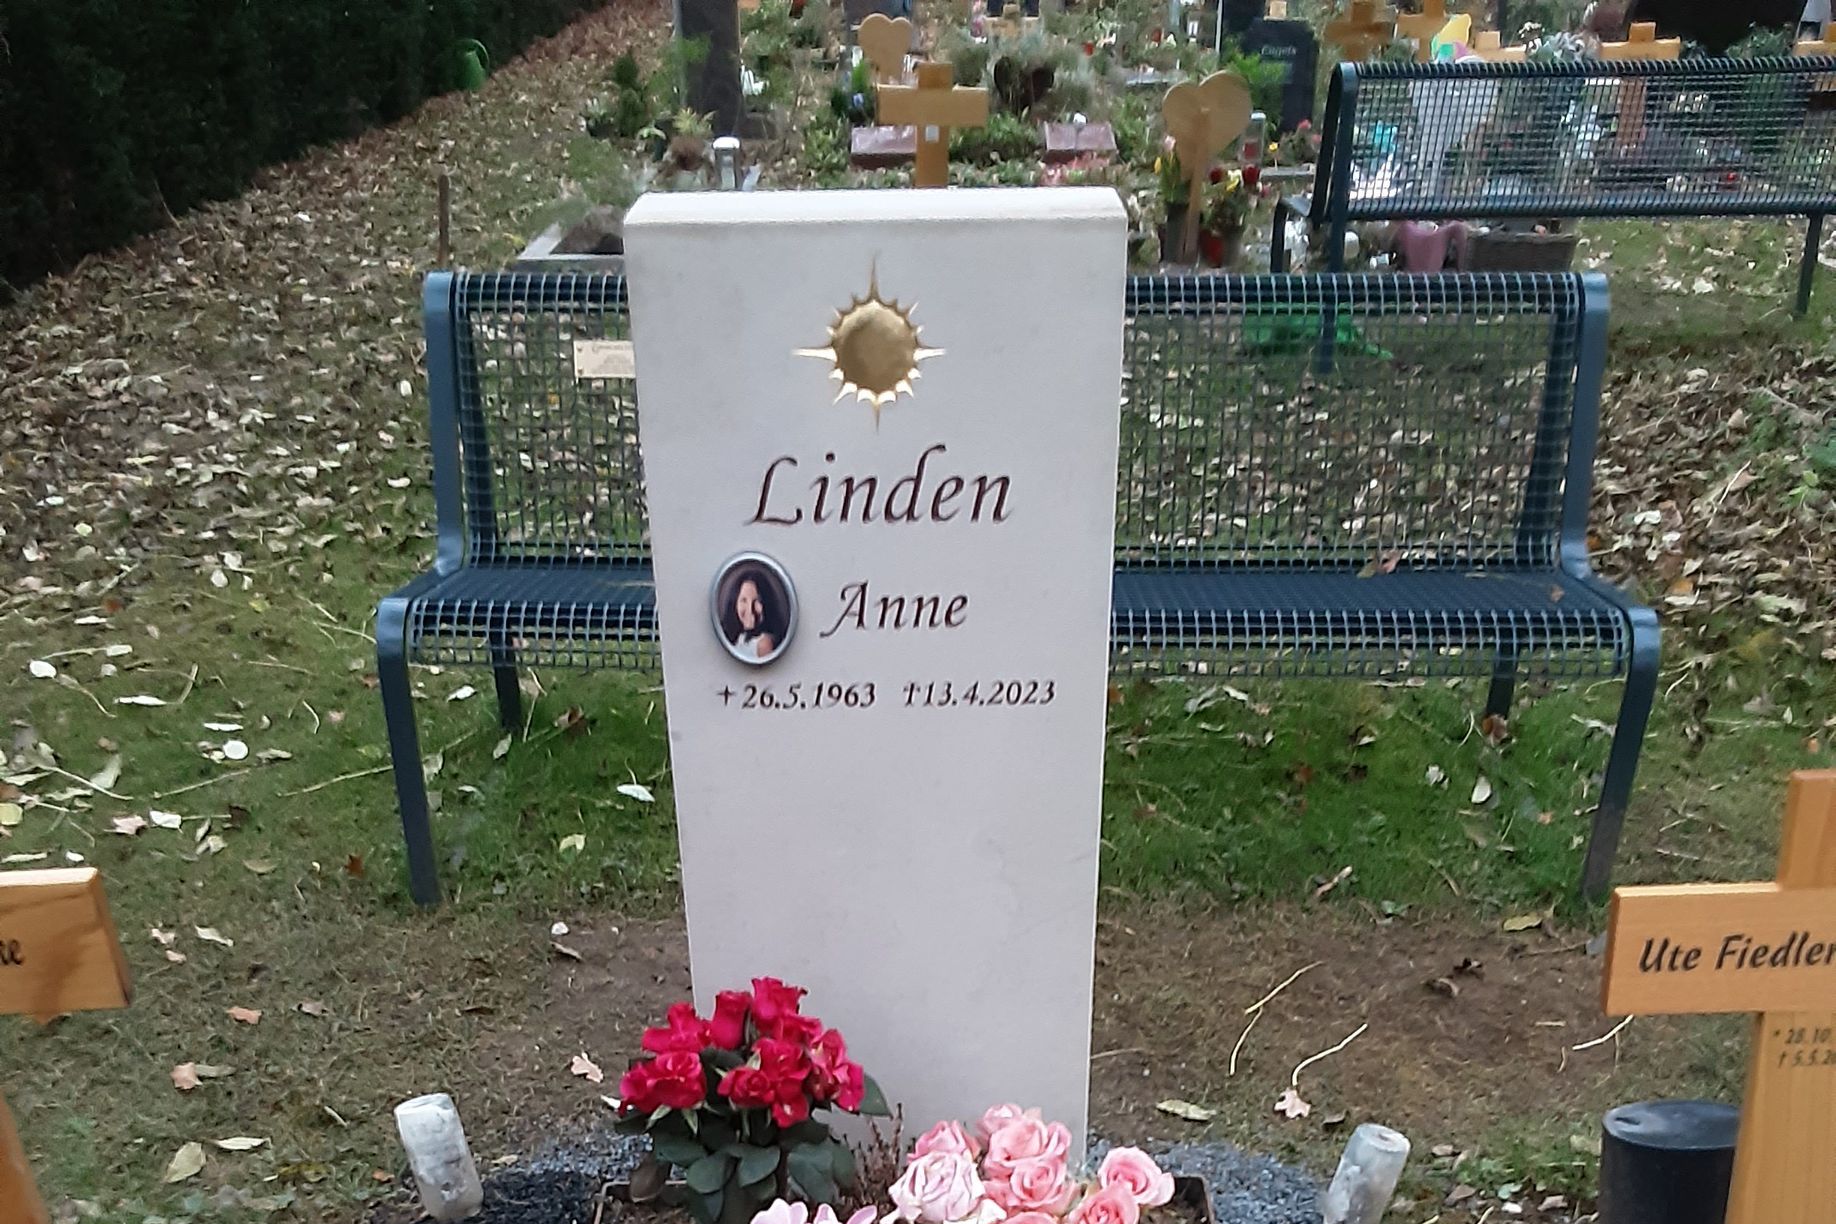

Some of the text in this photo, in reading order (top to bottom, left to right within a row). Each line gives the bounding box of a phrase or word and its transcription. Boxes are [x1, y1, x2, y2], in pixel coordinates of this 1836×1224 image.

[742, 443, 1015, 527] Linden
[819, 579, 970, 639] Anne
[1639, 936, 1702, 974] Ute
